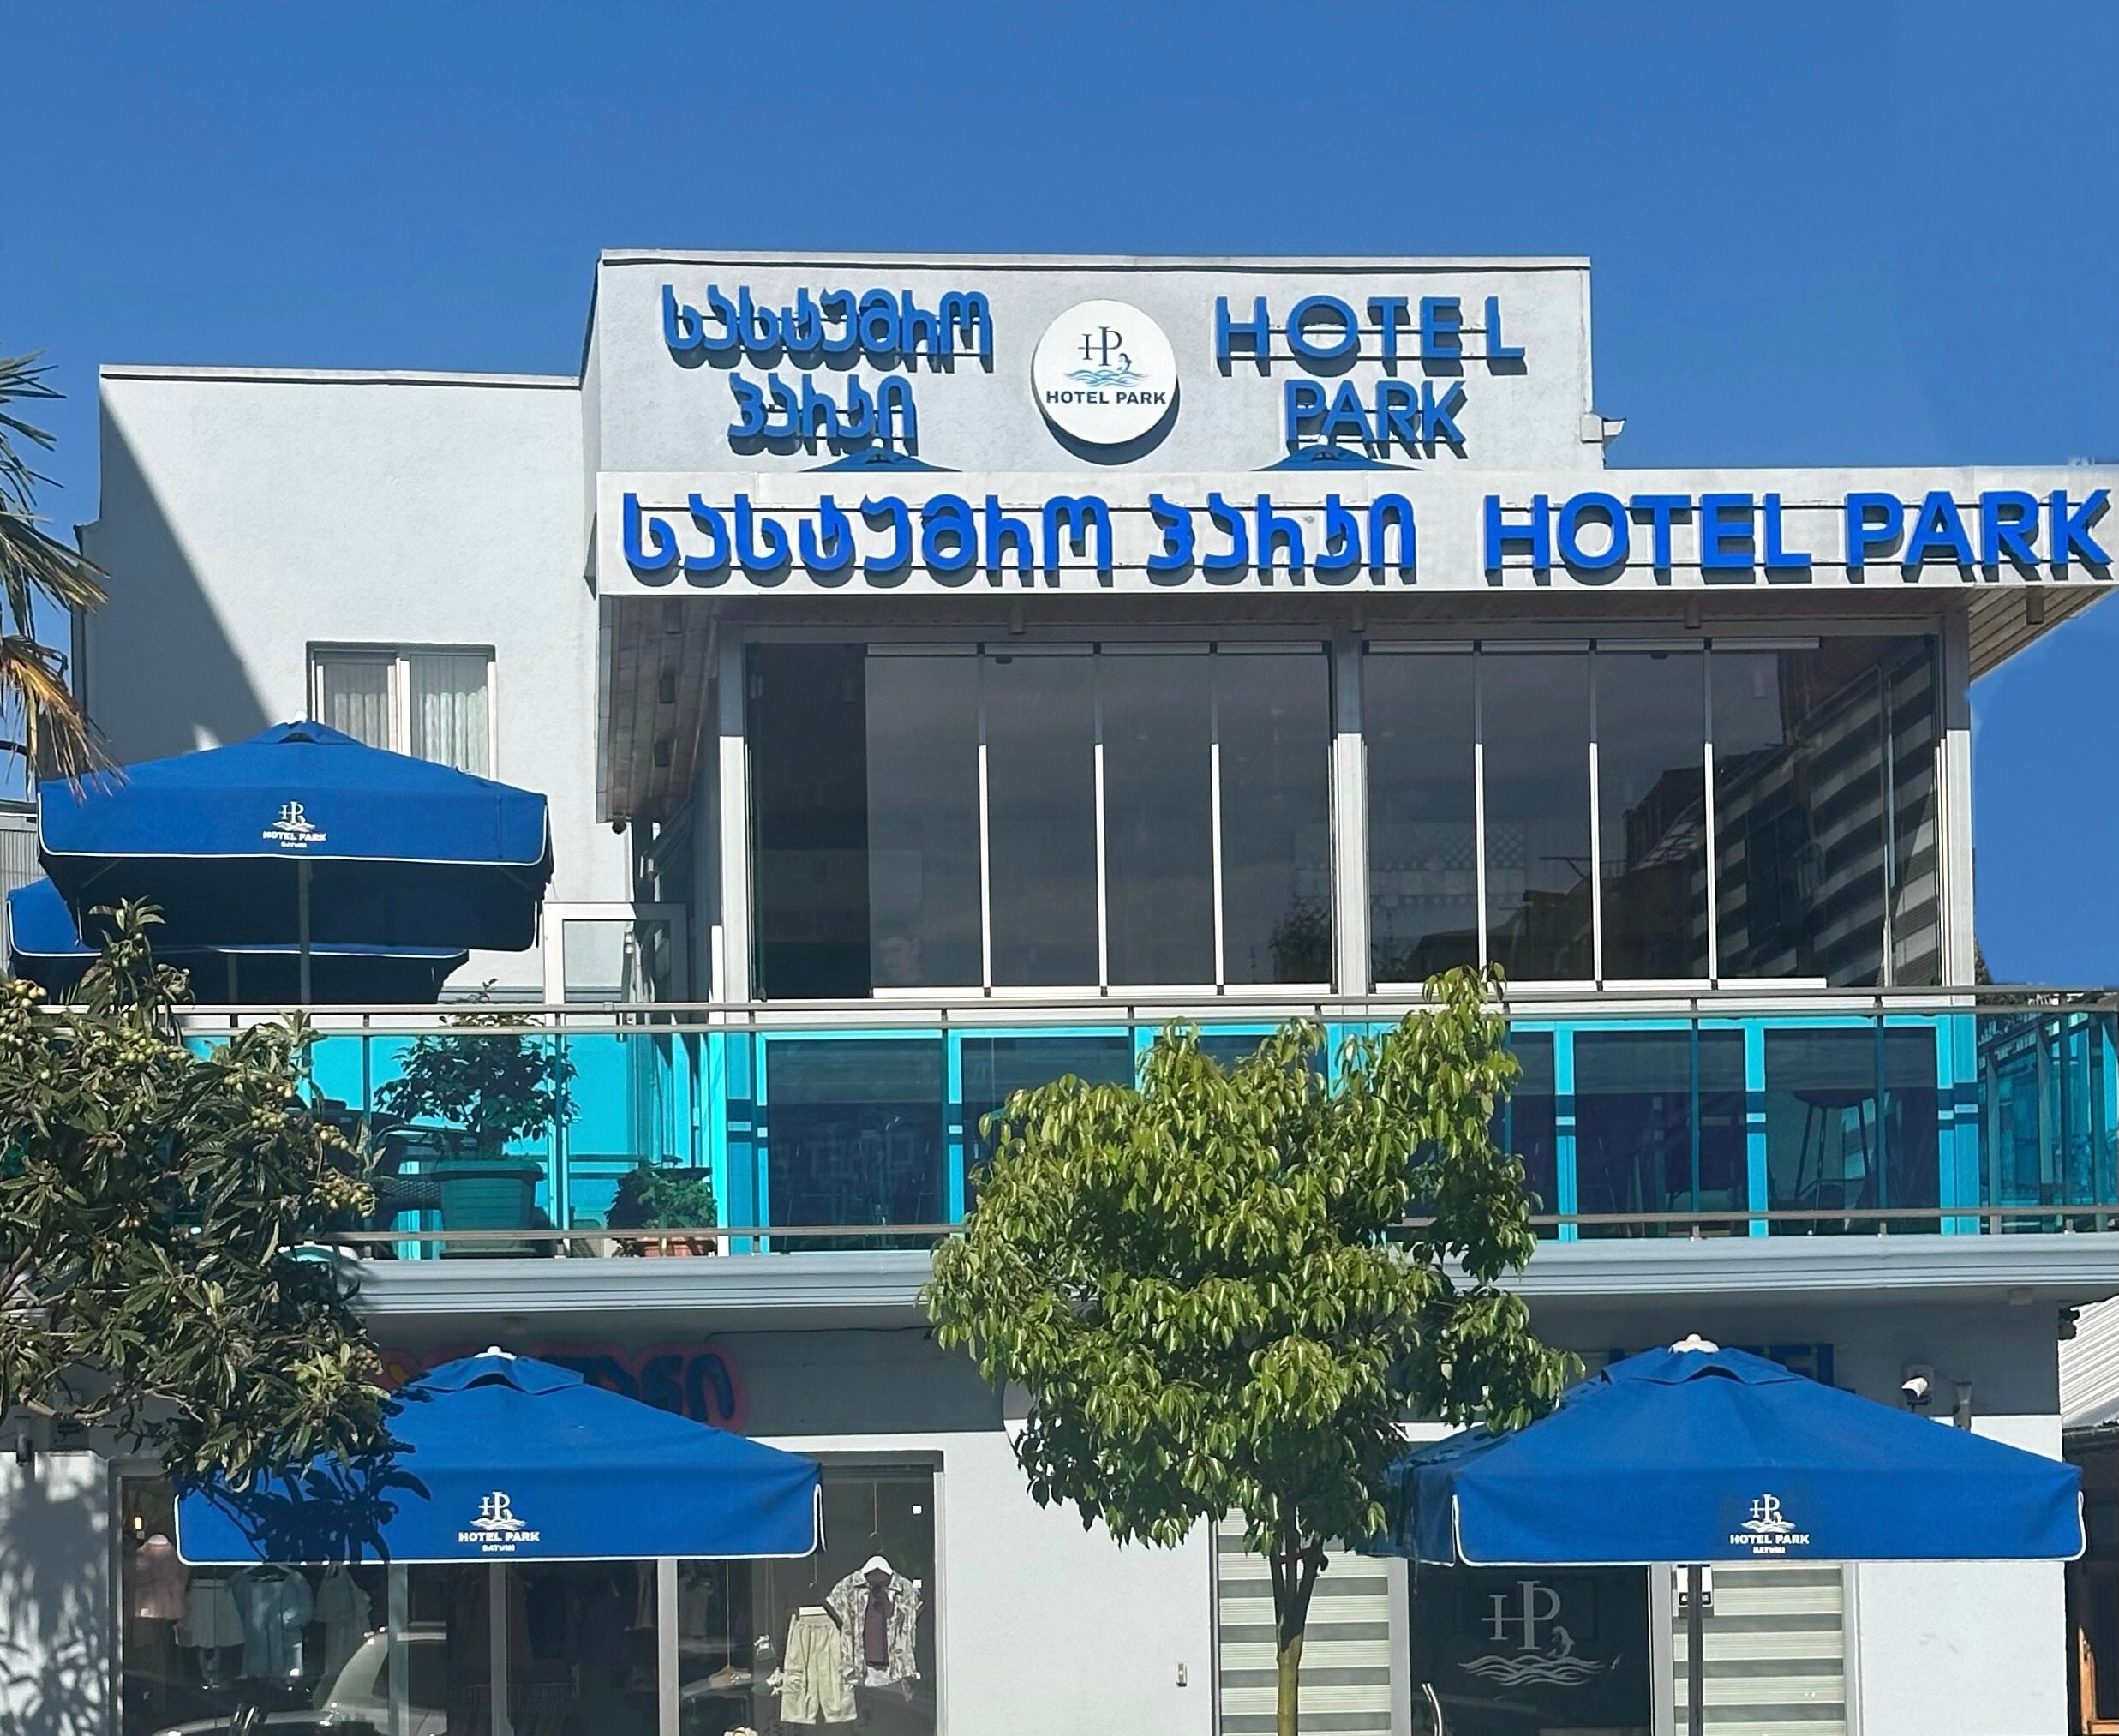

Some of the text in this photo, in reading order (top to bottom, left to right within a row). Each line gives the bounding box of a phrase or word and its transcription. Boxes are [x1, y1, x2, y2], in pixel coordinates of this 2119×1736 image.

[661, 284, 991, 356] სასტუმრო
[1216, 295, 1524, 358] HOTEL
[727, 372, 916, 440] პარკი
[1046, 391, 1166, 405] HOTEL PARK
[1286, 379, 1466, 443] PARK
[623, 492, 1416, 572] სასტუმრო პარკი
[1483, 488, 2115, 570] HOTEL PARK
[262, 831, 326, 841] HOTEL PARK
[458, 1531, 540, 1542] HOTEL PARK
[1730, 1534, 1810, 1544] HOTEL PARK
